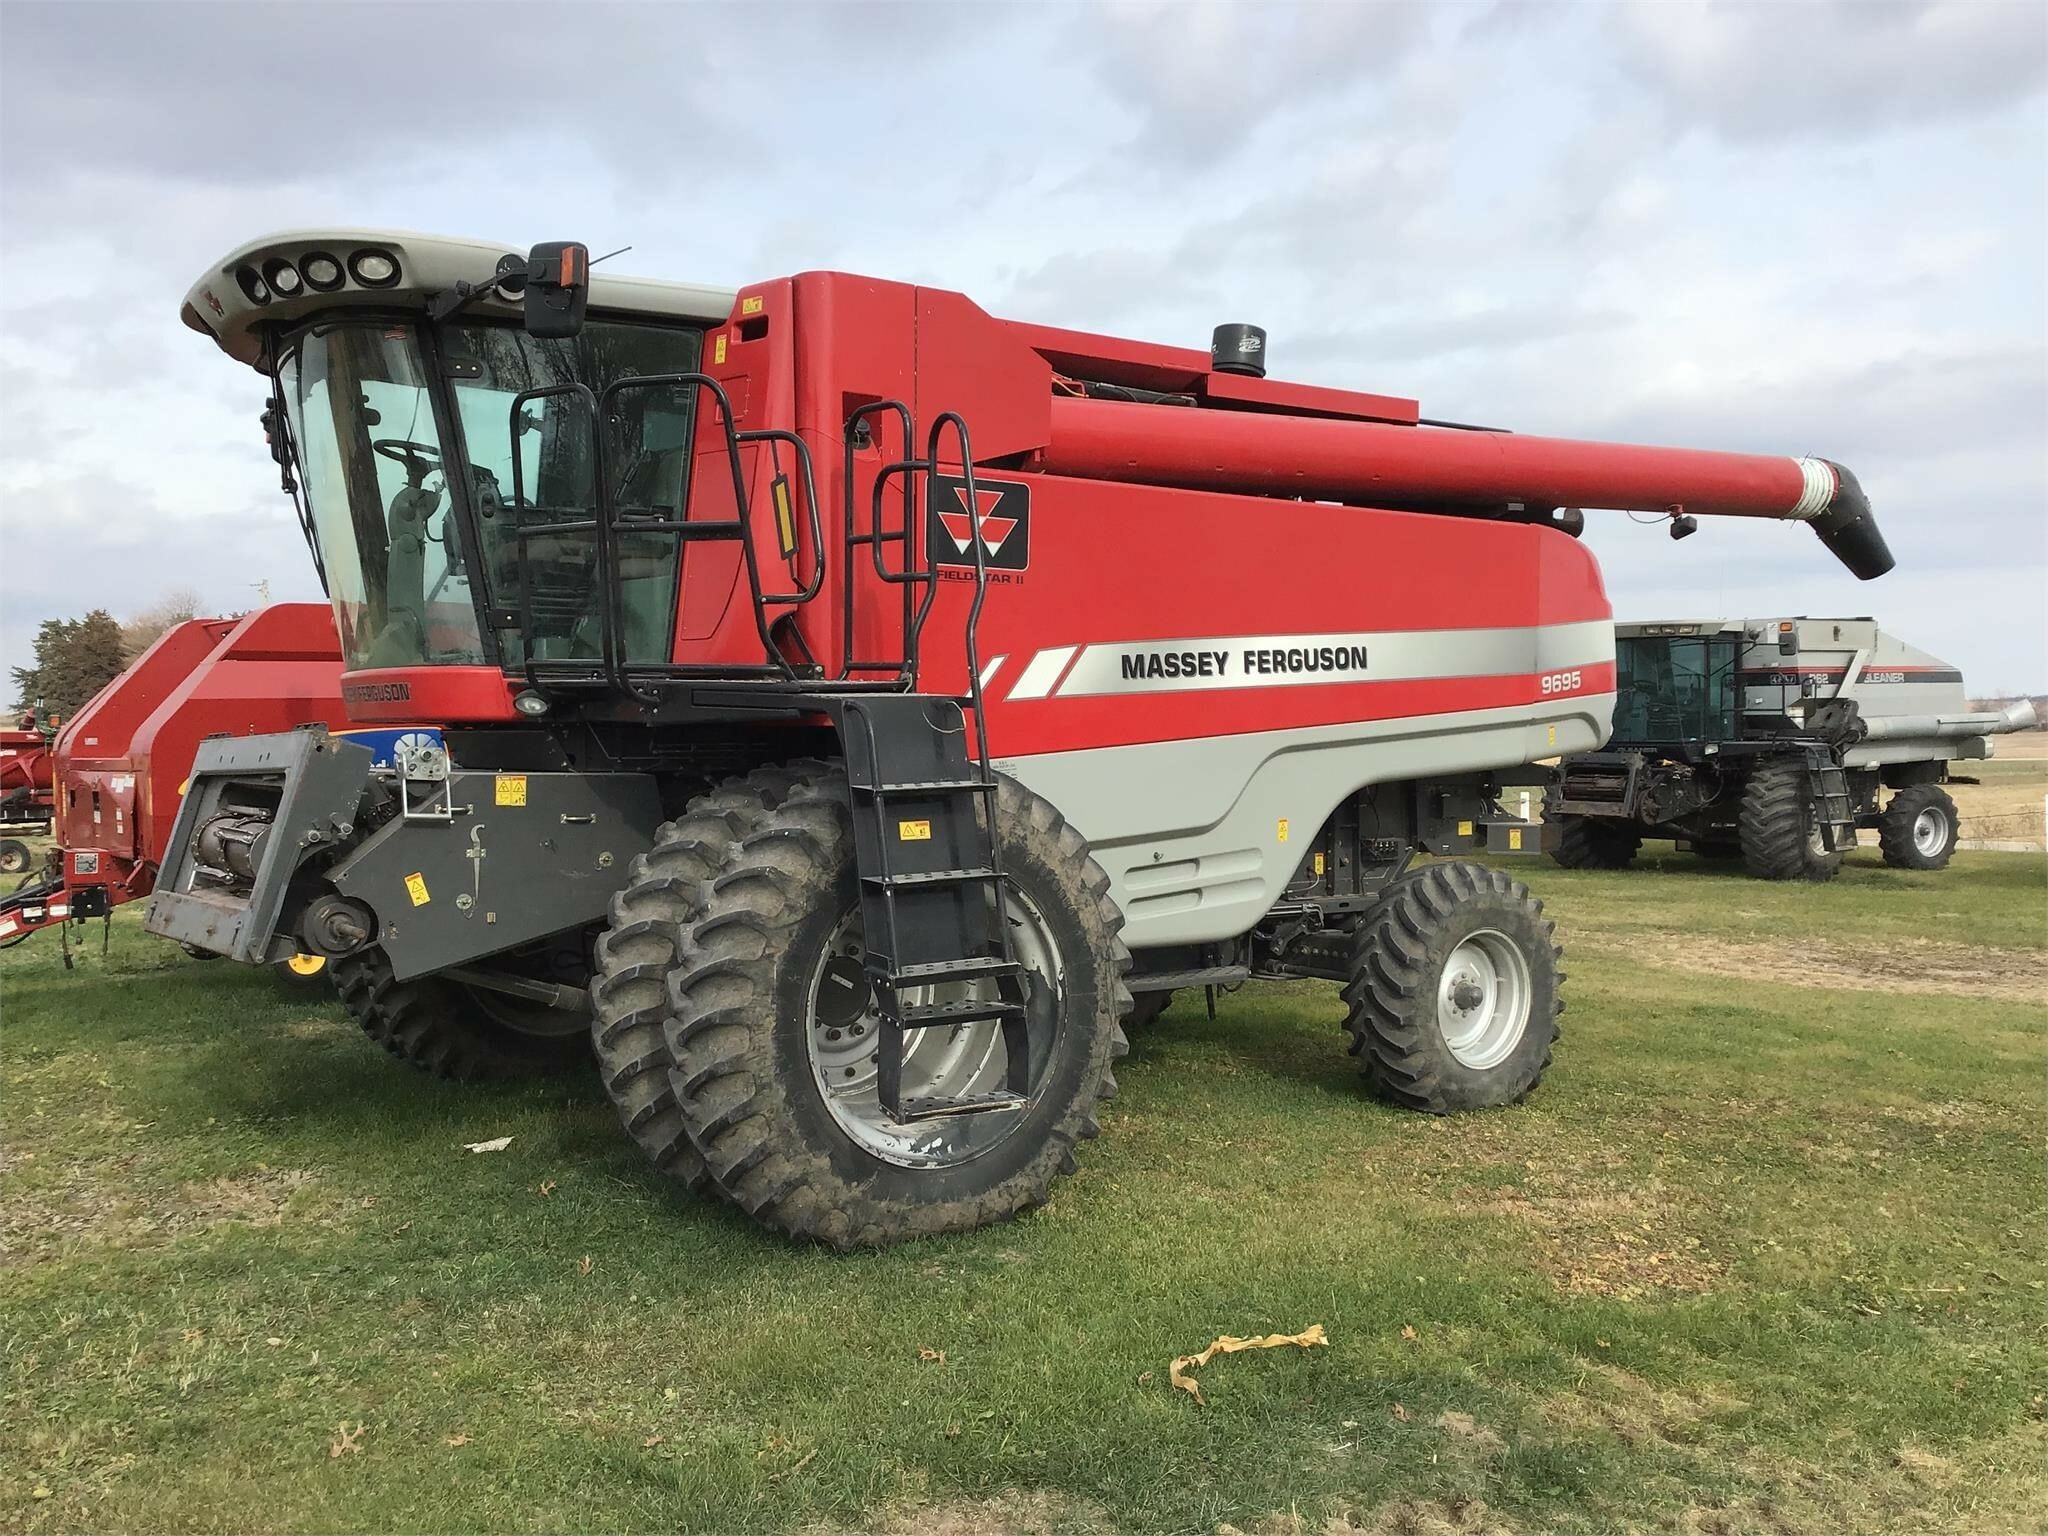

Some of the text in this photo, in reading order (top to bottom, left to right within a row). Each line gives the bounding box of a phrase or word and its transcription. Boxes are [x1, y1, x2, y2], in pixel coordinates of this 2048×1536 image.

[937, 570, 1024, 584] FIELDTAR II
[1121, 646, 1368, 679] MASSEY FERGUSON
[1541, 670, 1581, 695] 9695
